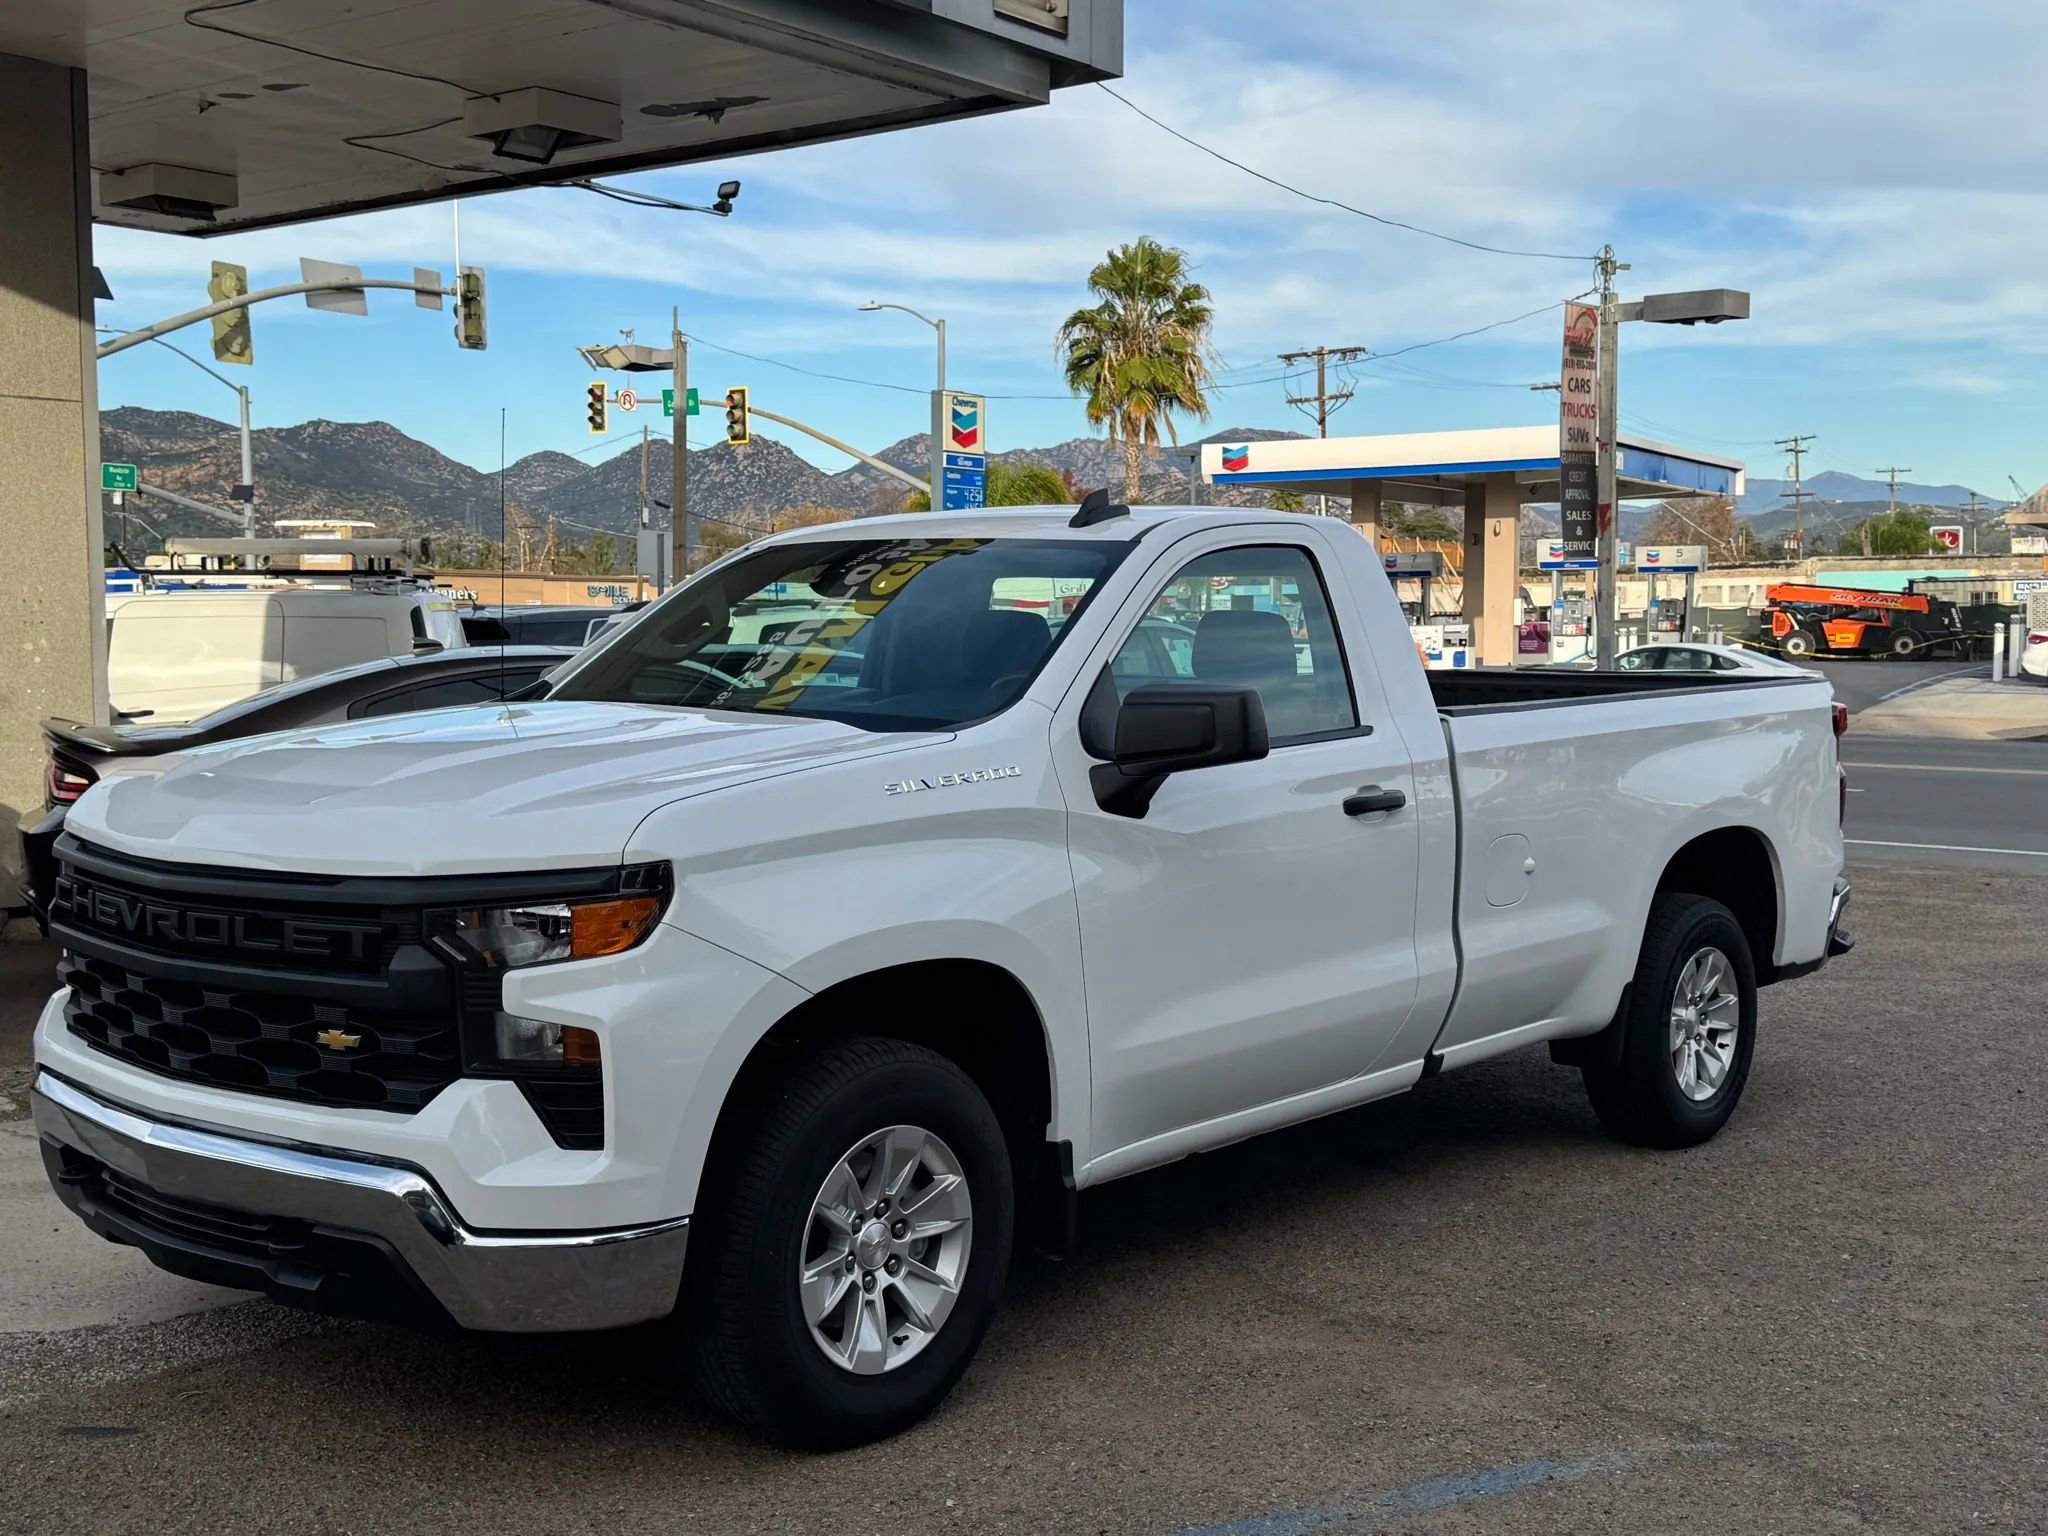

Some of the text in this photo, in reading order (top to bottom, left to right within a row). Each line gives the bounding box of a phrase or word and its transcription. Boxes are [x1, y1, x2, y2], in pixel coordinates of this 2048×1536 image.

[1568, 377, 1591, 394] CARS
[952, 395, 978, 409] Chevron
[1562, 401, 1596, 419] TRUCKS
[1568, 427, 1589, 443] SUVs
[1566, 510, 1592, 521] SALES
[1575, 525, 1584, 536] &
[1675, 548, 1683, 558] 5
[884, 764, 1023, 796] SILVERADO
[54, 875, 385, 960] CHEVROLET
